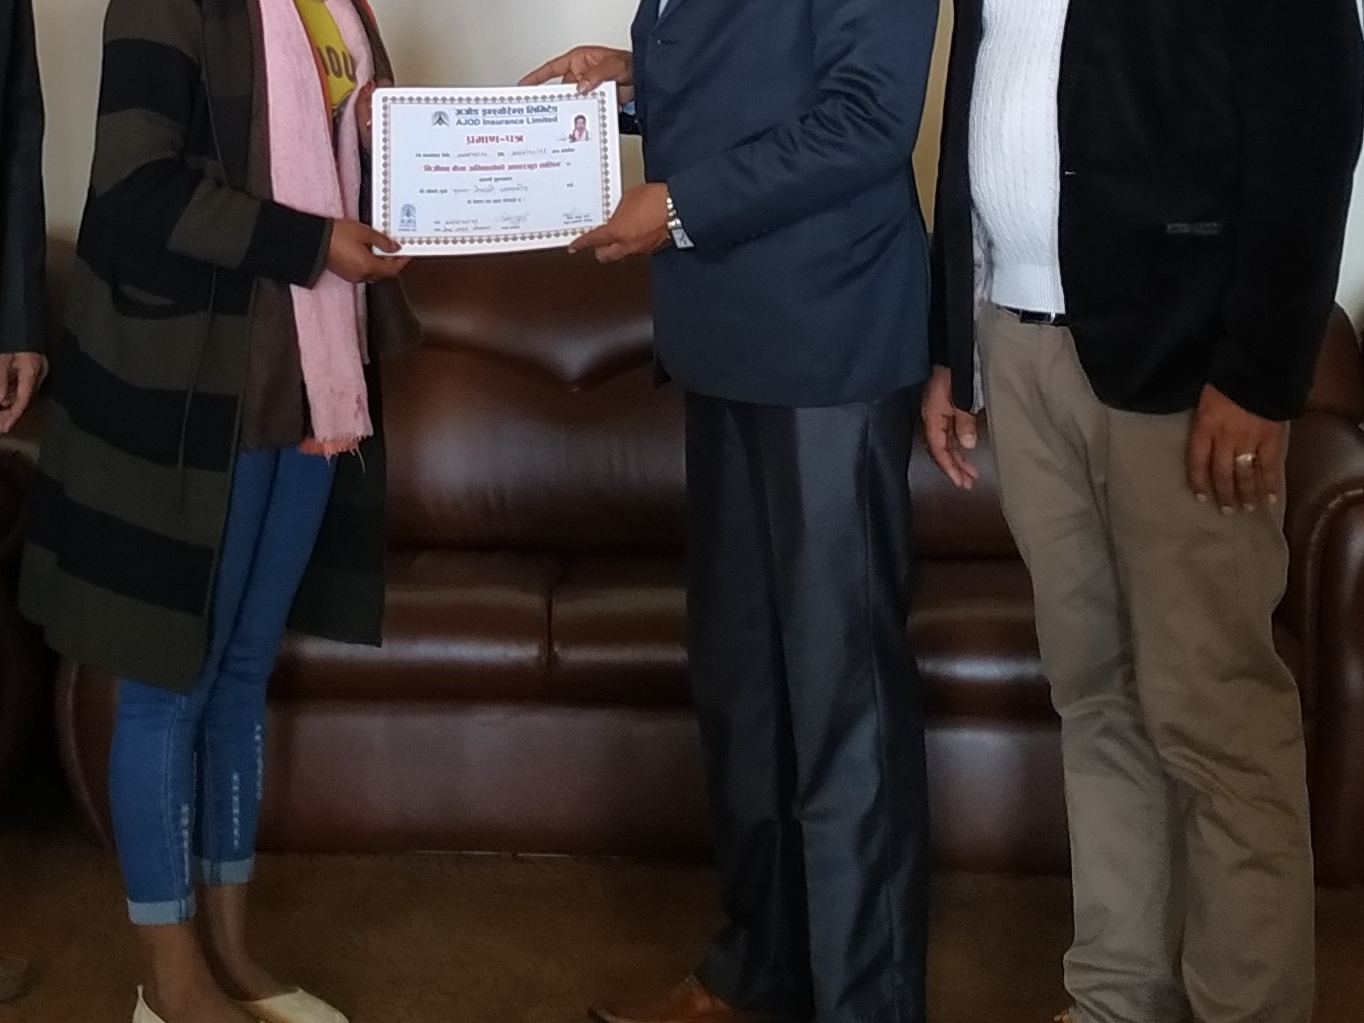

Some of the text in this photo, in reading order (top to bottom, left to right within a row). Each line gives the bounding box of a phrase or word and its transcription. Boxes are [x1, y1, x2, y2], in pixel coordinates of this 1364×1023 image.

[456, 116, 558, 126] AJOD Insurance Limited
